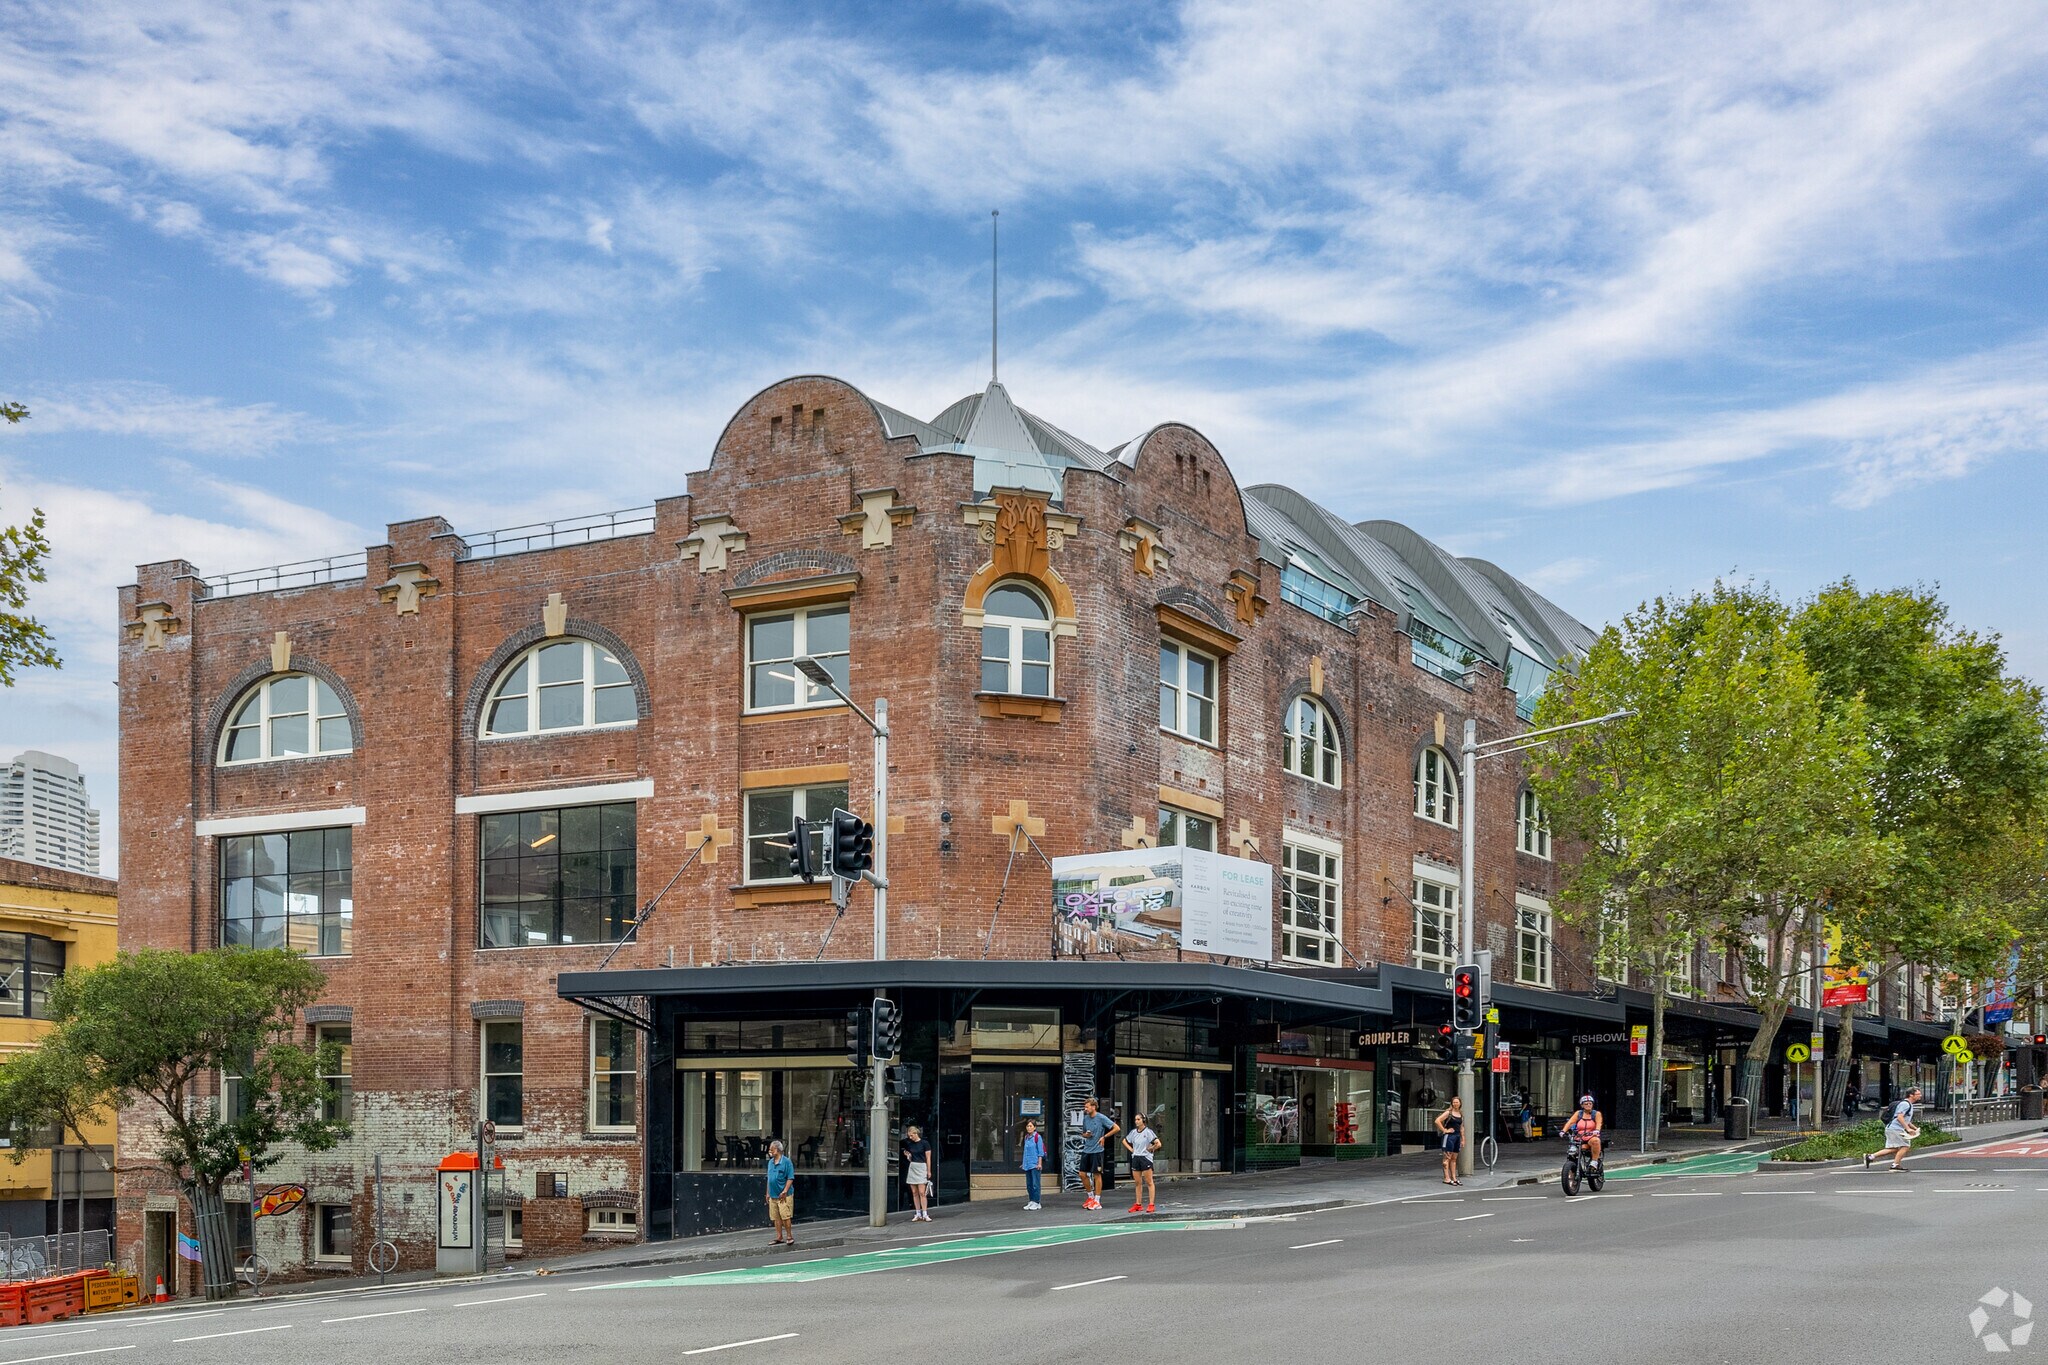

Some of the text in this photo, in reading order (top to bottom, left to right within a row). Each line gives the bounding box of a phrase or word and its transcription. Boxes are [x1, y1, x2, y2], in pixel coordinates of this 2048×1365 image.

[1223, 870, 1264, 886] FOR LEASE
[1065, 886, 1166, 906] OXFORD
[1229, 910, 1253, 922] creativity
[1192, 939, 1209, 948] CBRE
[1358, 1031, 1411, 1046] CRUMPLER
[1571, 1032, 1629, 1044] FISHBOWL
